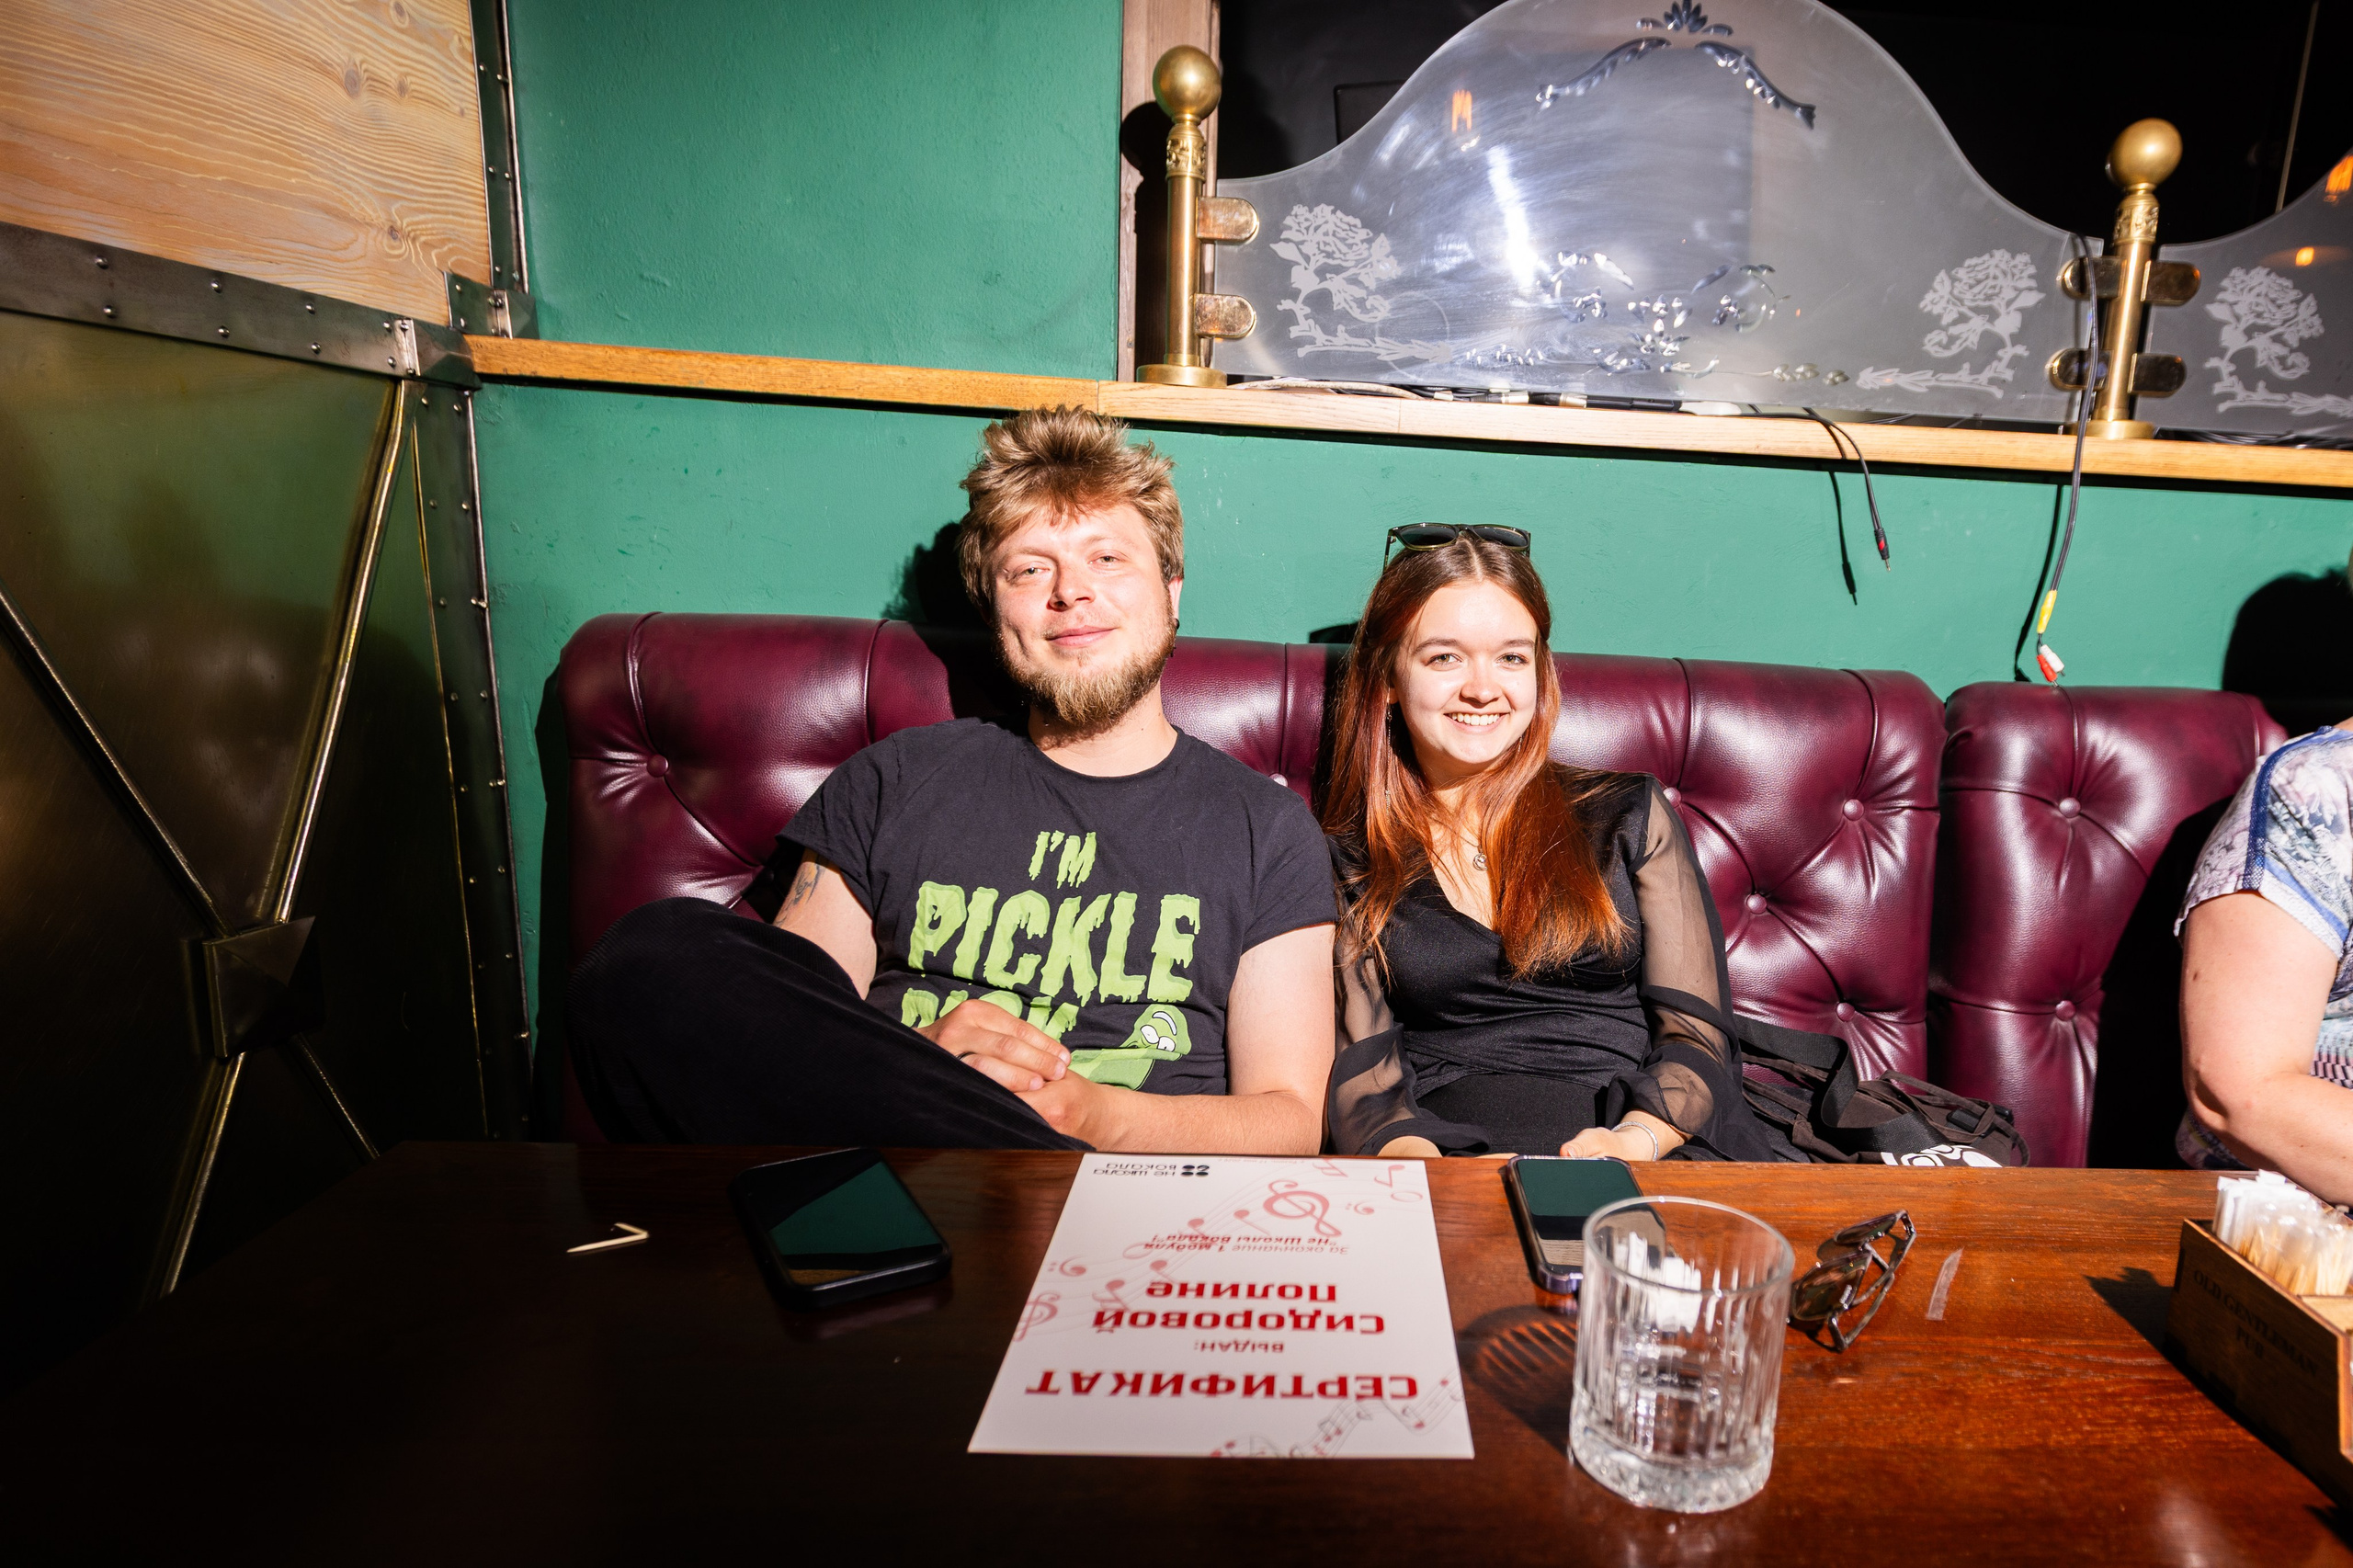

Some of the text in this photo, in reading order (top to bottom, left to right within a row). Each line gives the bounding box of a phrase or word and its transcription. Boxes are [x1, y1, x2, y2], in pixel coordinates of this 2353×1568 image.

[1028, 830, 1097, 889] I'M
[907, 881, 1200, 1007] PICKLE
[1232, 1244, 1325, 1255] окончание
[1236, 1235, 1302, 1246] Школы
[1329, 1244, 1349, 1256] За
[1145, 1281, 1338, 1303] Полине
[1092, 1309, 1386, 1335] Сидоровой
[2193, 1269, 2318, 1377] OLD GENTLEMAN
[1024, 1369, 1419, 1400] СЕРТИФИКАТ
